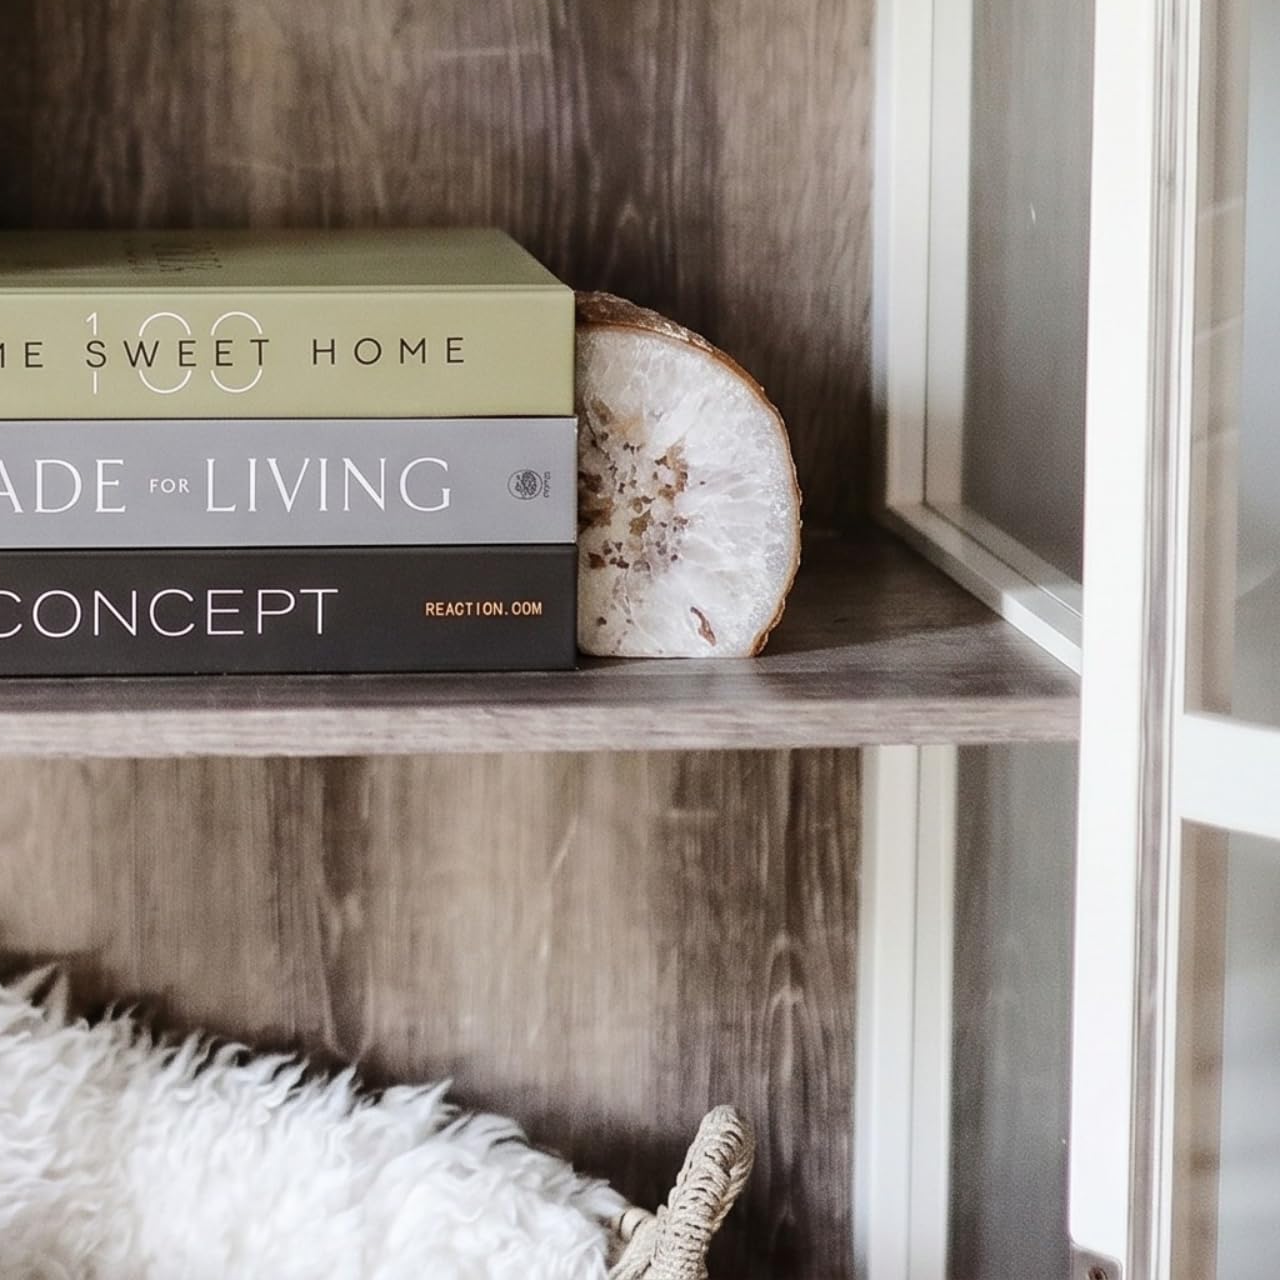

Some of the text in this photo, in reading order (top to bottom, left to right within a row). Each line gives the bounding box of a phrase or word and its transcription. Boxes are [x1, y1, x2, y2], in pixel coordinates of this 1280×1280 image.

[86, 339, 270, 368] SWEET
[312, 336, 465, 366] HOME
[149, 478, 190, 494] FOR
[206, 457, 451, 513] LIVING
